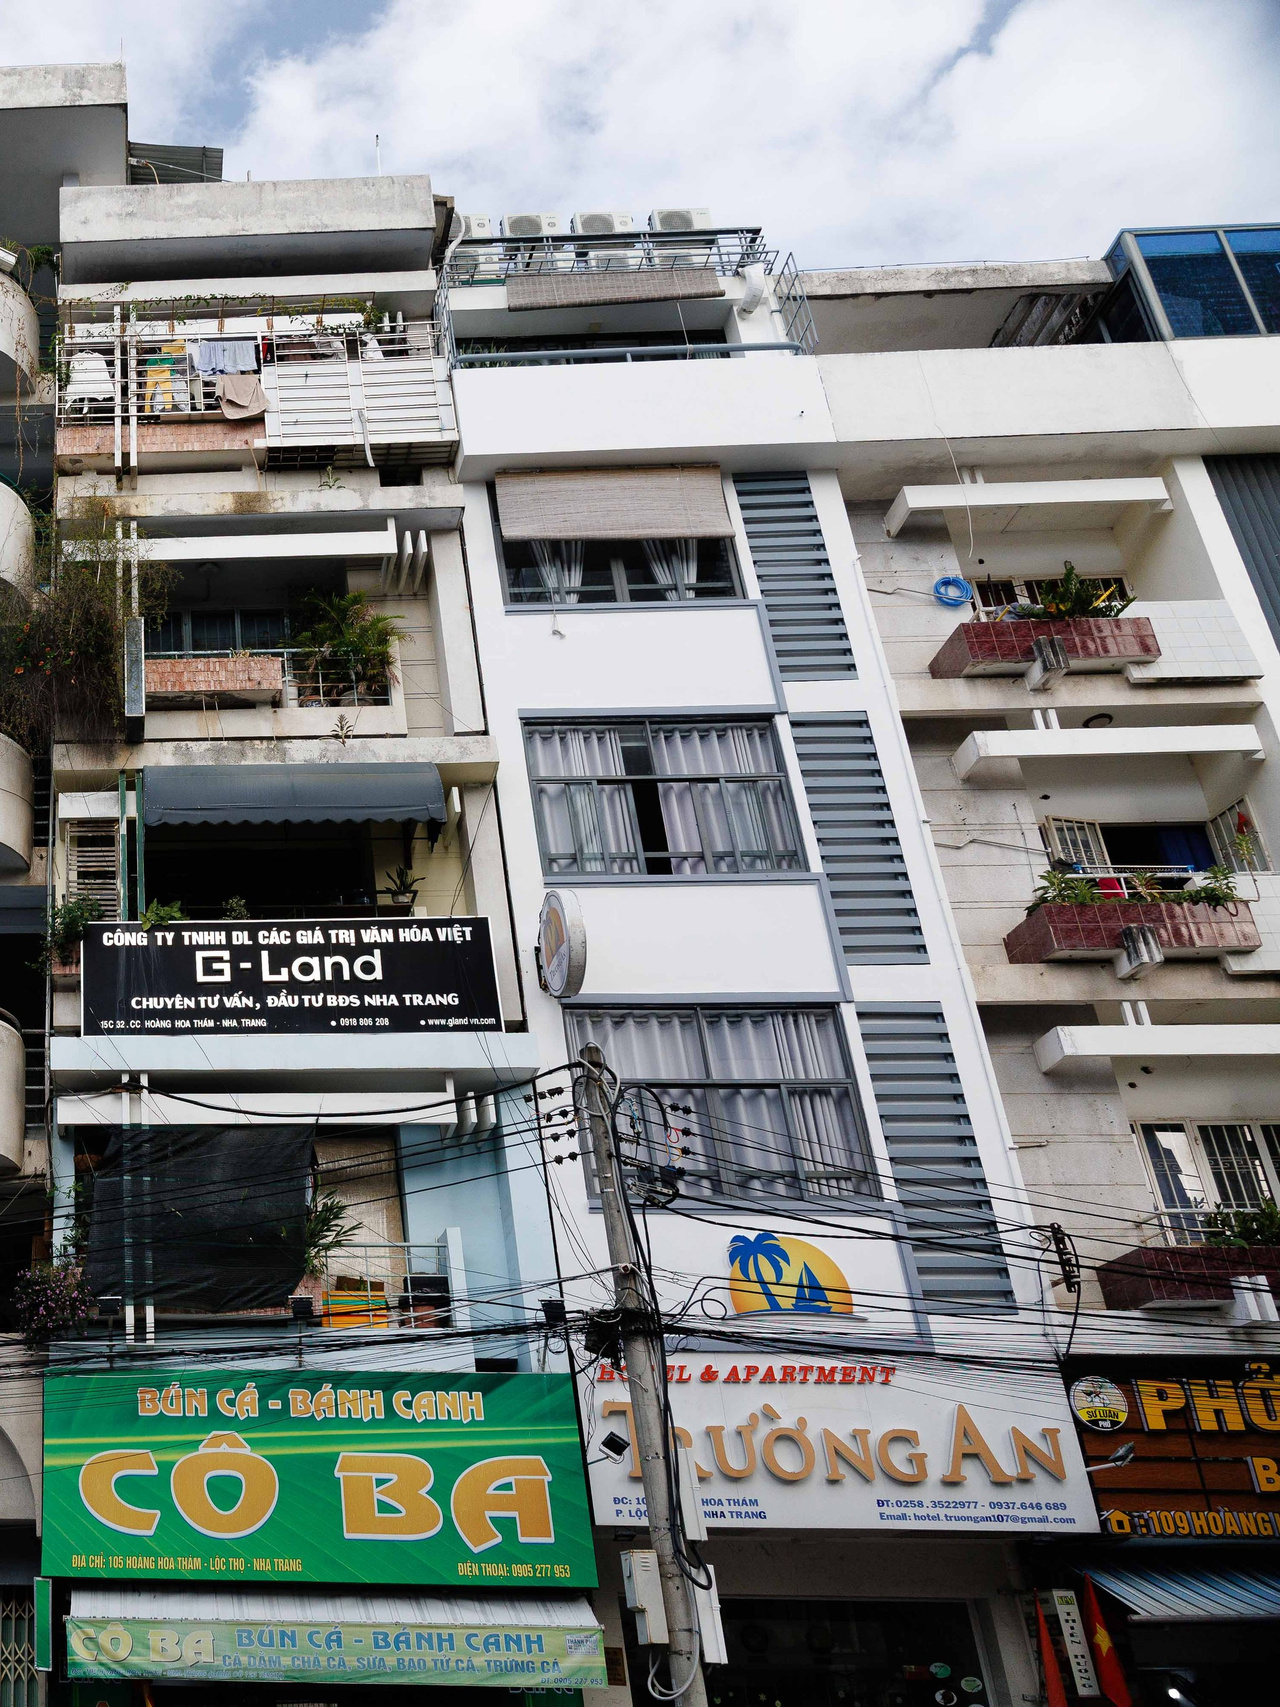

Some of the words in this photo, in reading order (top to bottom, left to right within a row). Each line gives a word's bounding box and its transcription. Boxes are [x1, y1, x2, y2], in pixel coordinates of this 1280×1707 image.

[102, 929, 148, 946] CÔNG
[155, 932, 175, 945] TY
[182, 931, 226, 945] TNHH
[232, 930, 253, 945] DL
[258, 927, 291, 945] CÁC
[296, 926, 325, 944] GIÁ
[328, 929, 355, 946] TRỊ
[360, 926, 394, 943] VĂN
[398, 925, 434, 942] HÓA
[435, 924, 473, 944] VIỆT
[131, 994, 196, 1010] CHUYÊN
[198, 994, 220, 1009] TƯ
[266, 989, 299, 1008] ĐẦU
[301, 992, 324, 1007] TƯ
[327, 994, 360, 1007] BĐS
[365, 994, 399, 1007] NHA
[402, 993, 459, 1006] TRANG
[145, 1018, 171, 1028] HOÀNG
[175, 1019, 191, 1028] HOA
[194, 1018, 215, 1028] THÁM
[222, 1019, 238, 1028] NHA
[241, 1018, 266, 1028] TRANG
[340, 1017, 357, 1026] 0918
[359, 1017, 373, 1026] 806
[375, 1017, 389, 1026] 208
[723, 1364, 897, 1383] APARTMENT
[136, 1382, 209, 1418] BÚN
[216, 1382, 260, 1421] CÁ
[288, 1383, 386, 1423] BÁNH
[392, 1390, 486, 1424] CANH
[941, 1403, 1067, 1484] AN
[78, 1430, 280, 1540] CÔ
[334, 1452, 555, 1555] BA
[613, 1496, 632, 1505] ĐC:
[701, 1498, 724, 1507] HOA
[725, 1497, 759, 1507] THÁM
[615, 1509, 625, 1518] P.
[704, 1510, 726, 1519] NHA
[728, 1511, 767, 1520] TRANG
[72, 1554, 86, 1571] ĐỊA
[88, 1551, 106, 1569] CHỈ:
[108, 1556, 124, 1569] 105
[126, 1553, 155, 1570] HOÀNG
[157, 1557, 175, 1570] HOA
[177, 1554, 202, 1571] THÁM
[210, 1554, 226, 1574] LỘC
[228, 1557, 245, 1574] THỌ
[253, 1558, 271, 1571] NHA
[273, 1558, 303, 1572] TRANG
[458, 1560, 479, 1578] ĐIỆN
[481, 1563, 510, 1579] THOẠI:
[512, 1563, 533, 1577] 0905
[536, 1564, 551, 1578] 277
[554, 1564, 571, 1578] 953
[71, 1622, 133, 1663] CÔ
[147, 1629, 216, 1668] BA
[235, 1624, 298, 1650] BÚN
[306, 1625, 344, 1653] CÁ
[371, 1626, 457, 1655] BÁNH
[464, 1631, 546, 1656] CANH
[222, 1651, 243, 1669] CÁ
[291, 1651, 320, 1670] CHẢ
[326, 1653, 352, 1672] CÁ,
[356, 1654, 392, 1673] SỨA,
[396, 1657, 427, 1672] BAO
[430, 1653, 451, 1672] TỬ
[455, 1655, 481, 1675] CÁ,
[484, 1656, 536, 1674] TRỨNG
[540, 1658, 562, 1675] CÁ
